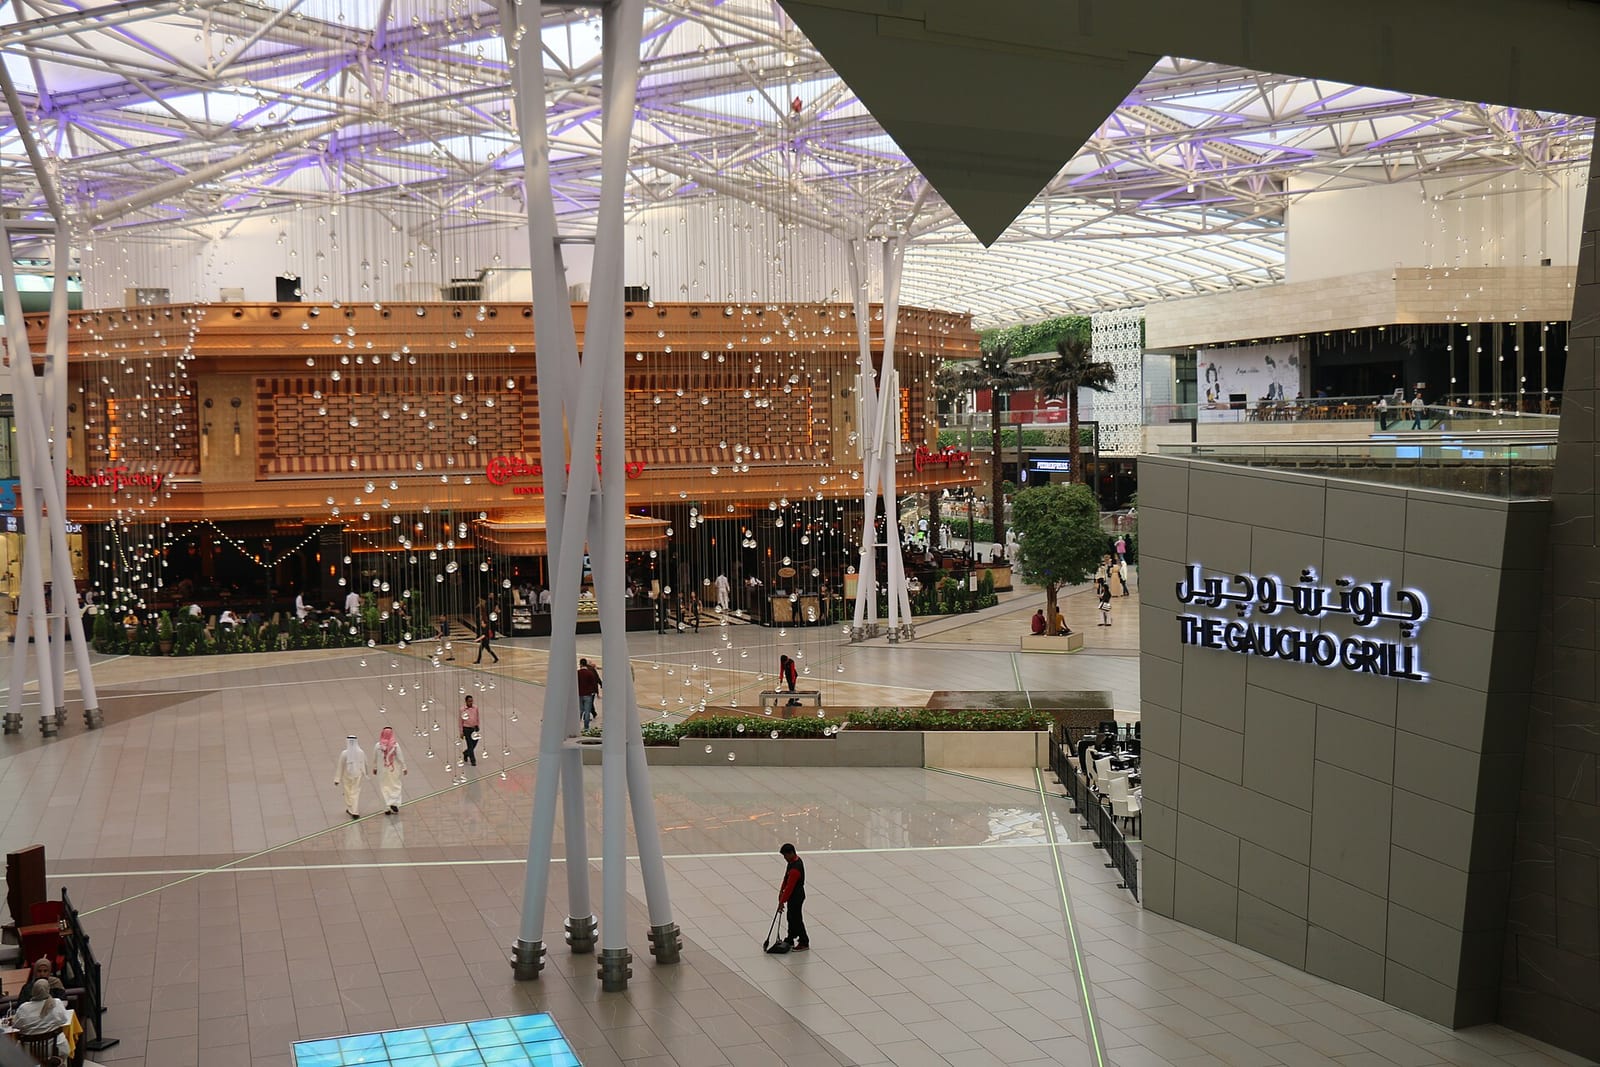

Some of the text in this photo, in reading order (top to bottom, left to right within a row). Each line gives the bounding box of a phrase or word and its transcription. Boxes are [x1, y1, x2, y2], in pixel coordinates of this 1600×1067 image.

[106, 466, 164, 493] Factory
[1176, 615, 1423, 681] THE GAUCHO GRILL
